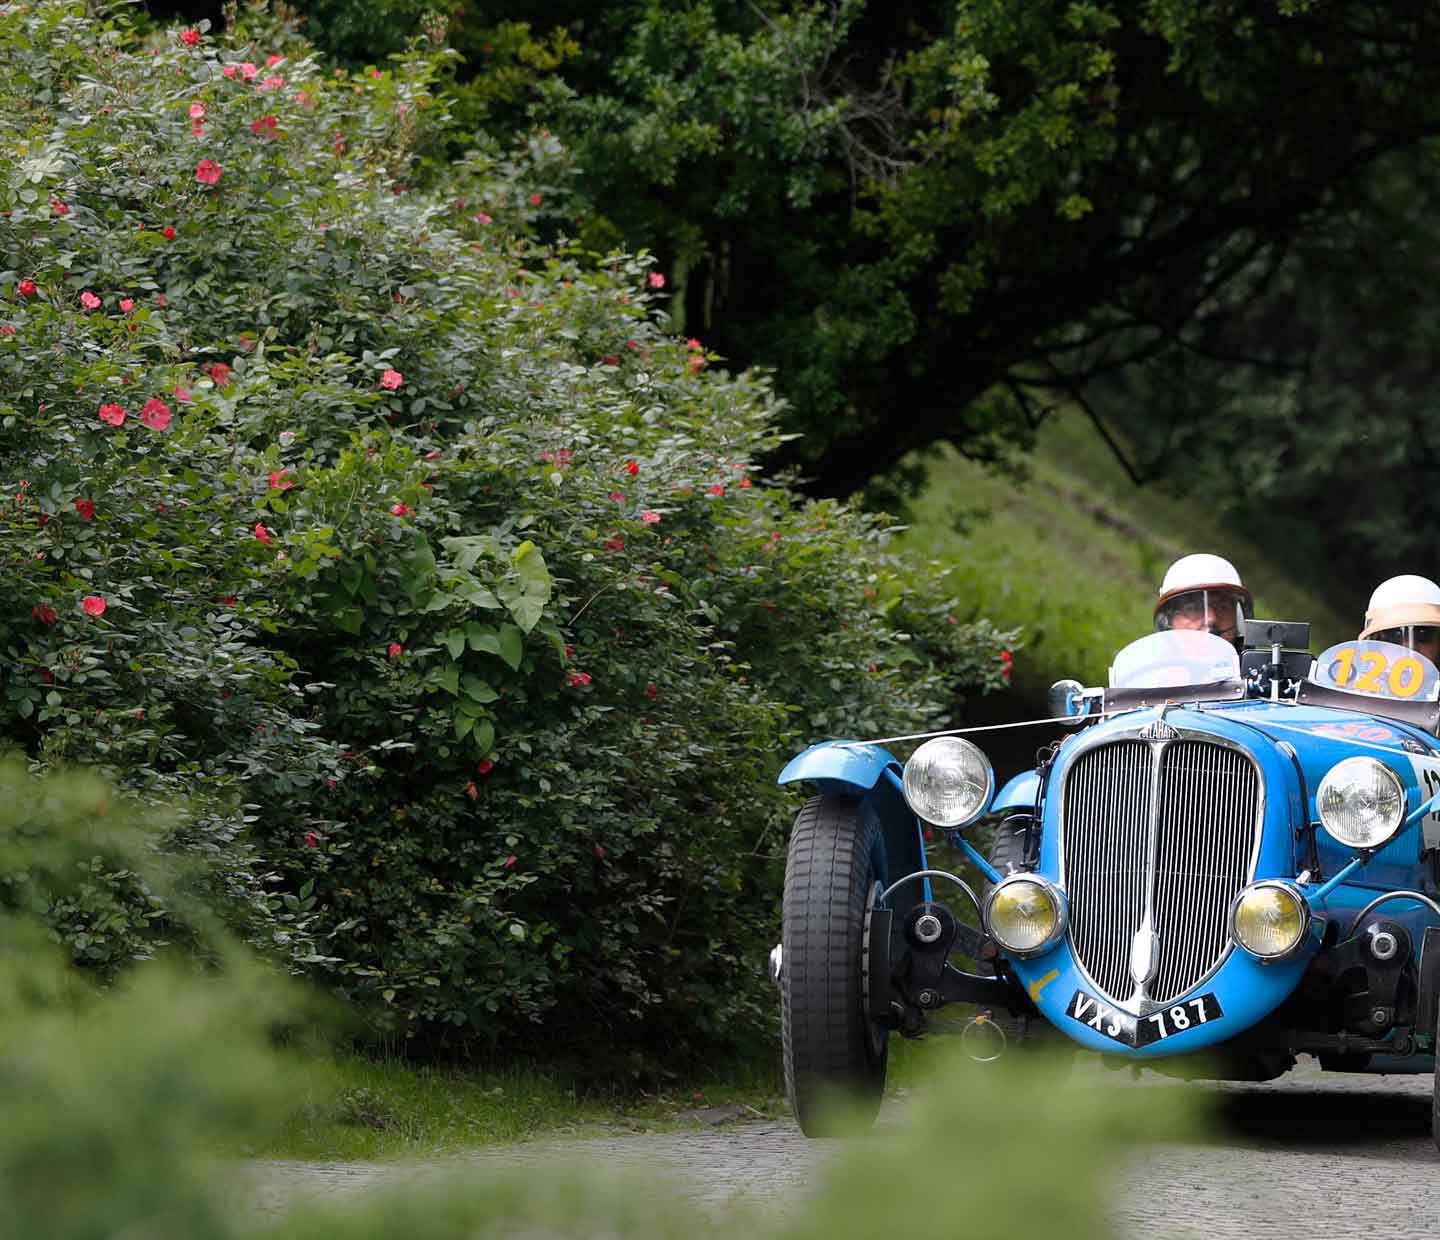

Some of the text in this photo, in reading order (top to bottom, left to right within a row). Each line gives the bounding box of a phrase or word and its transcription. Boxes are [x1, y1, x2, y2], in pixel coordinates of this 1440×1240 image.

[1332, 648, 1425, 698] 120
[1073, 992, 1208, 1039] VXS 787
